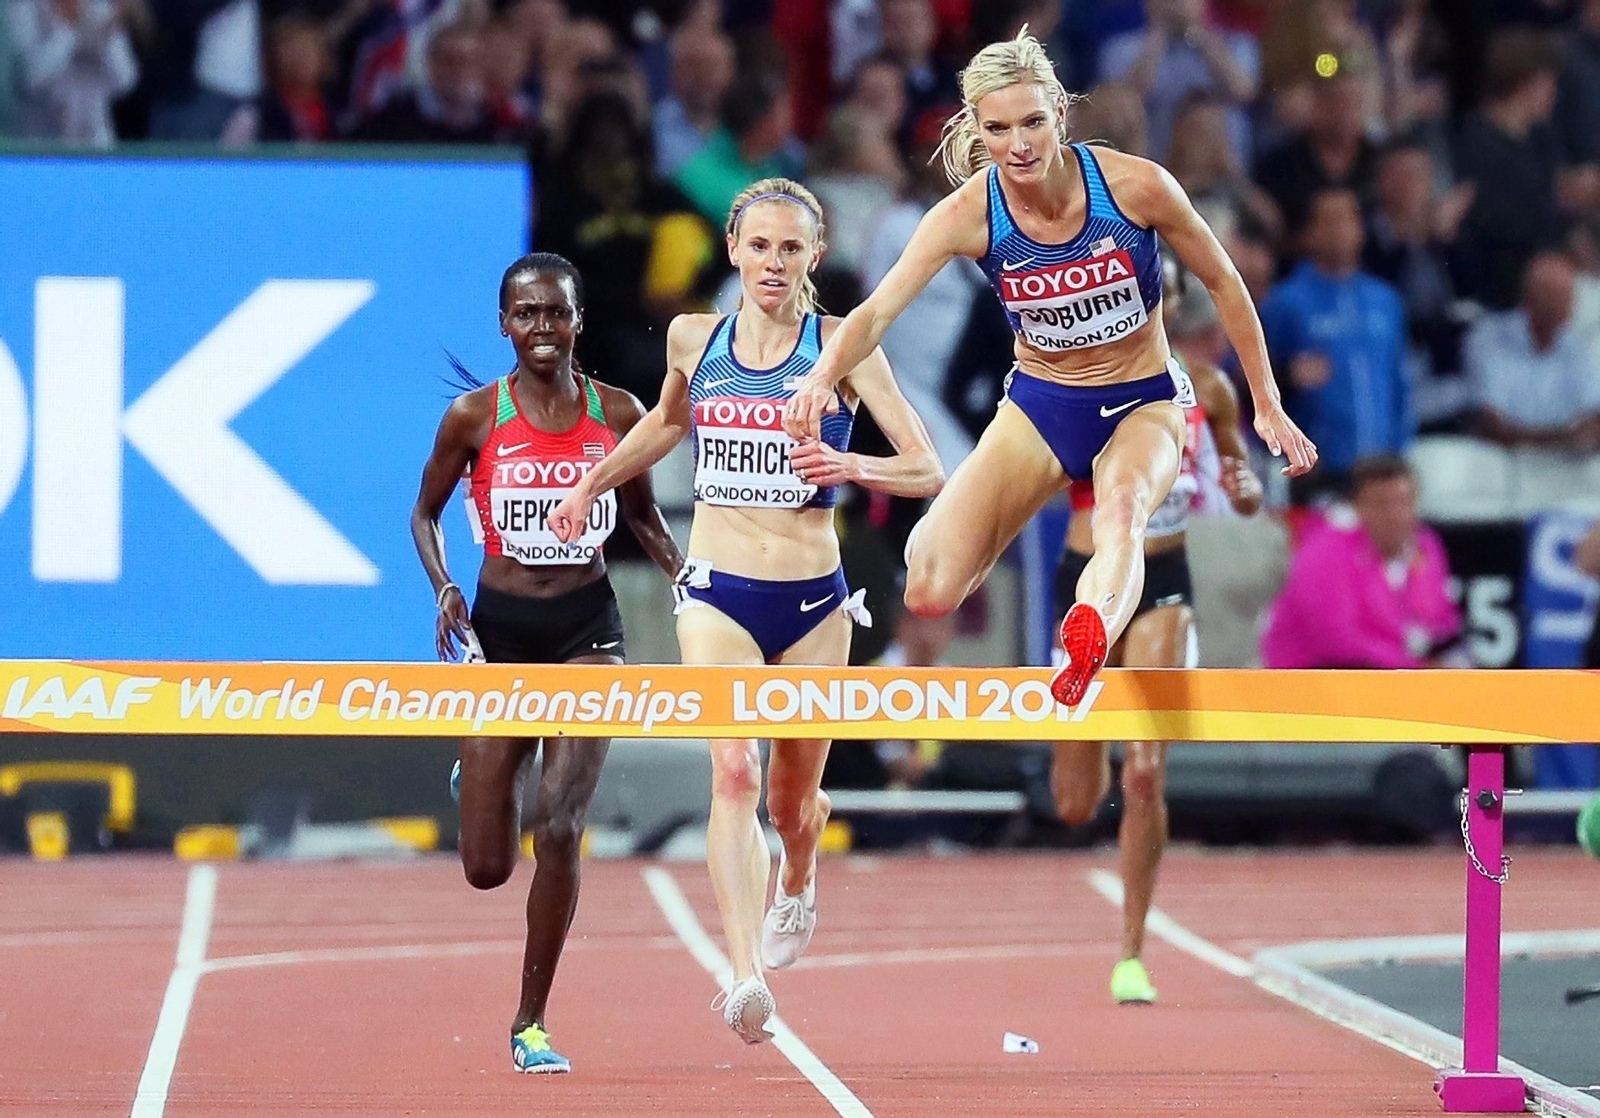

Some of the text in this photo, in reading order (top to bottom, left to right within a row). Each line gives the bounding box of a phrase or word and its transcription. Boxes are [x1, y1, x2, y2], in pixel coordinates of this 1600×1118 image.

[1004, 257, 1129, 298] TOYOTA
[1028, 310, 1142, 349] LONDON 2017
[0, 275, 383, 587] K
[701, 401, 793, 426] TOYOT
[497, 461, 601, 485] TOYOT
[703, 437, 801, 475] FRERICH
[771, 488, 811, 503] 2017
[2, 676, 162, 719] IAAF
[179, 677, 325, 721] World
[338, 677, 703, 732] Championships
[732, 678, 966, 722] LONDON
